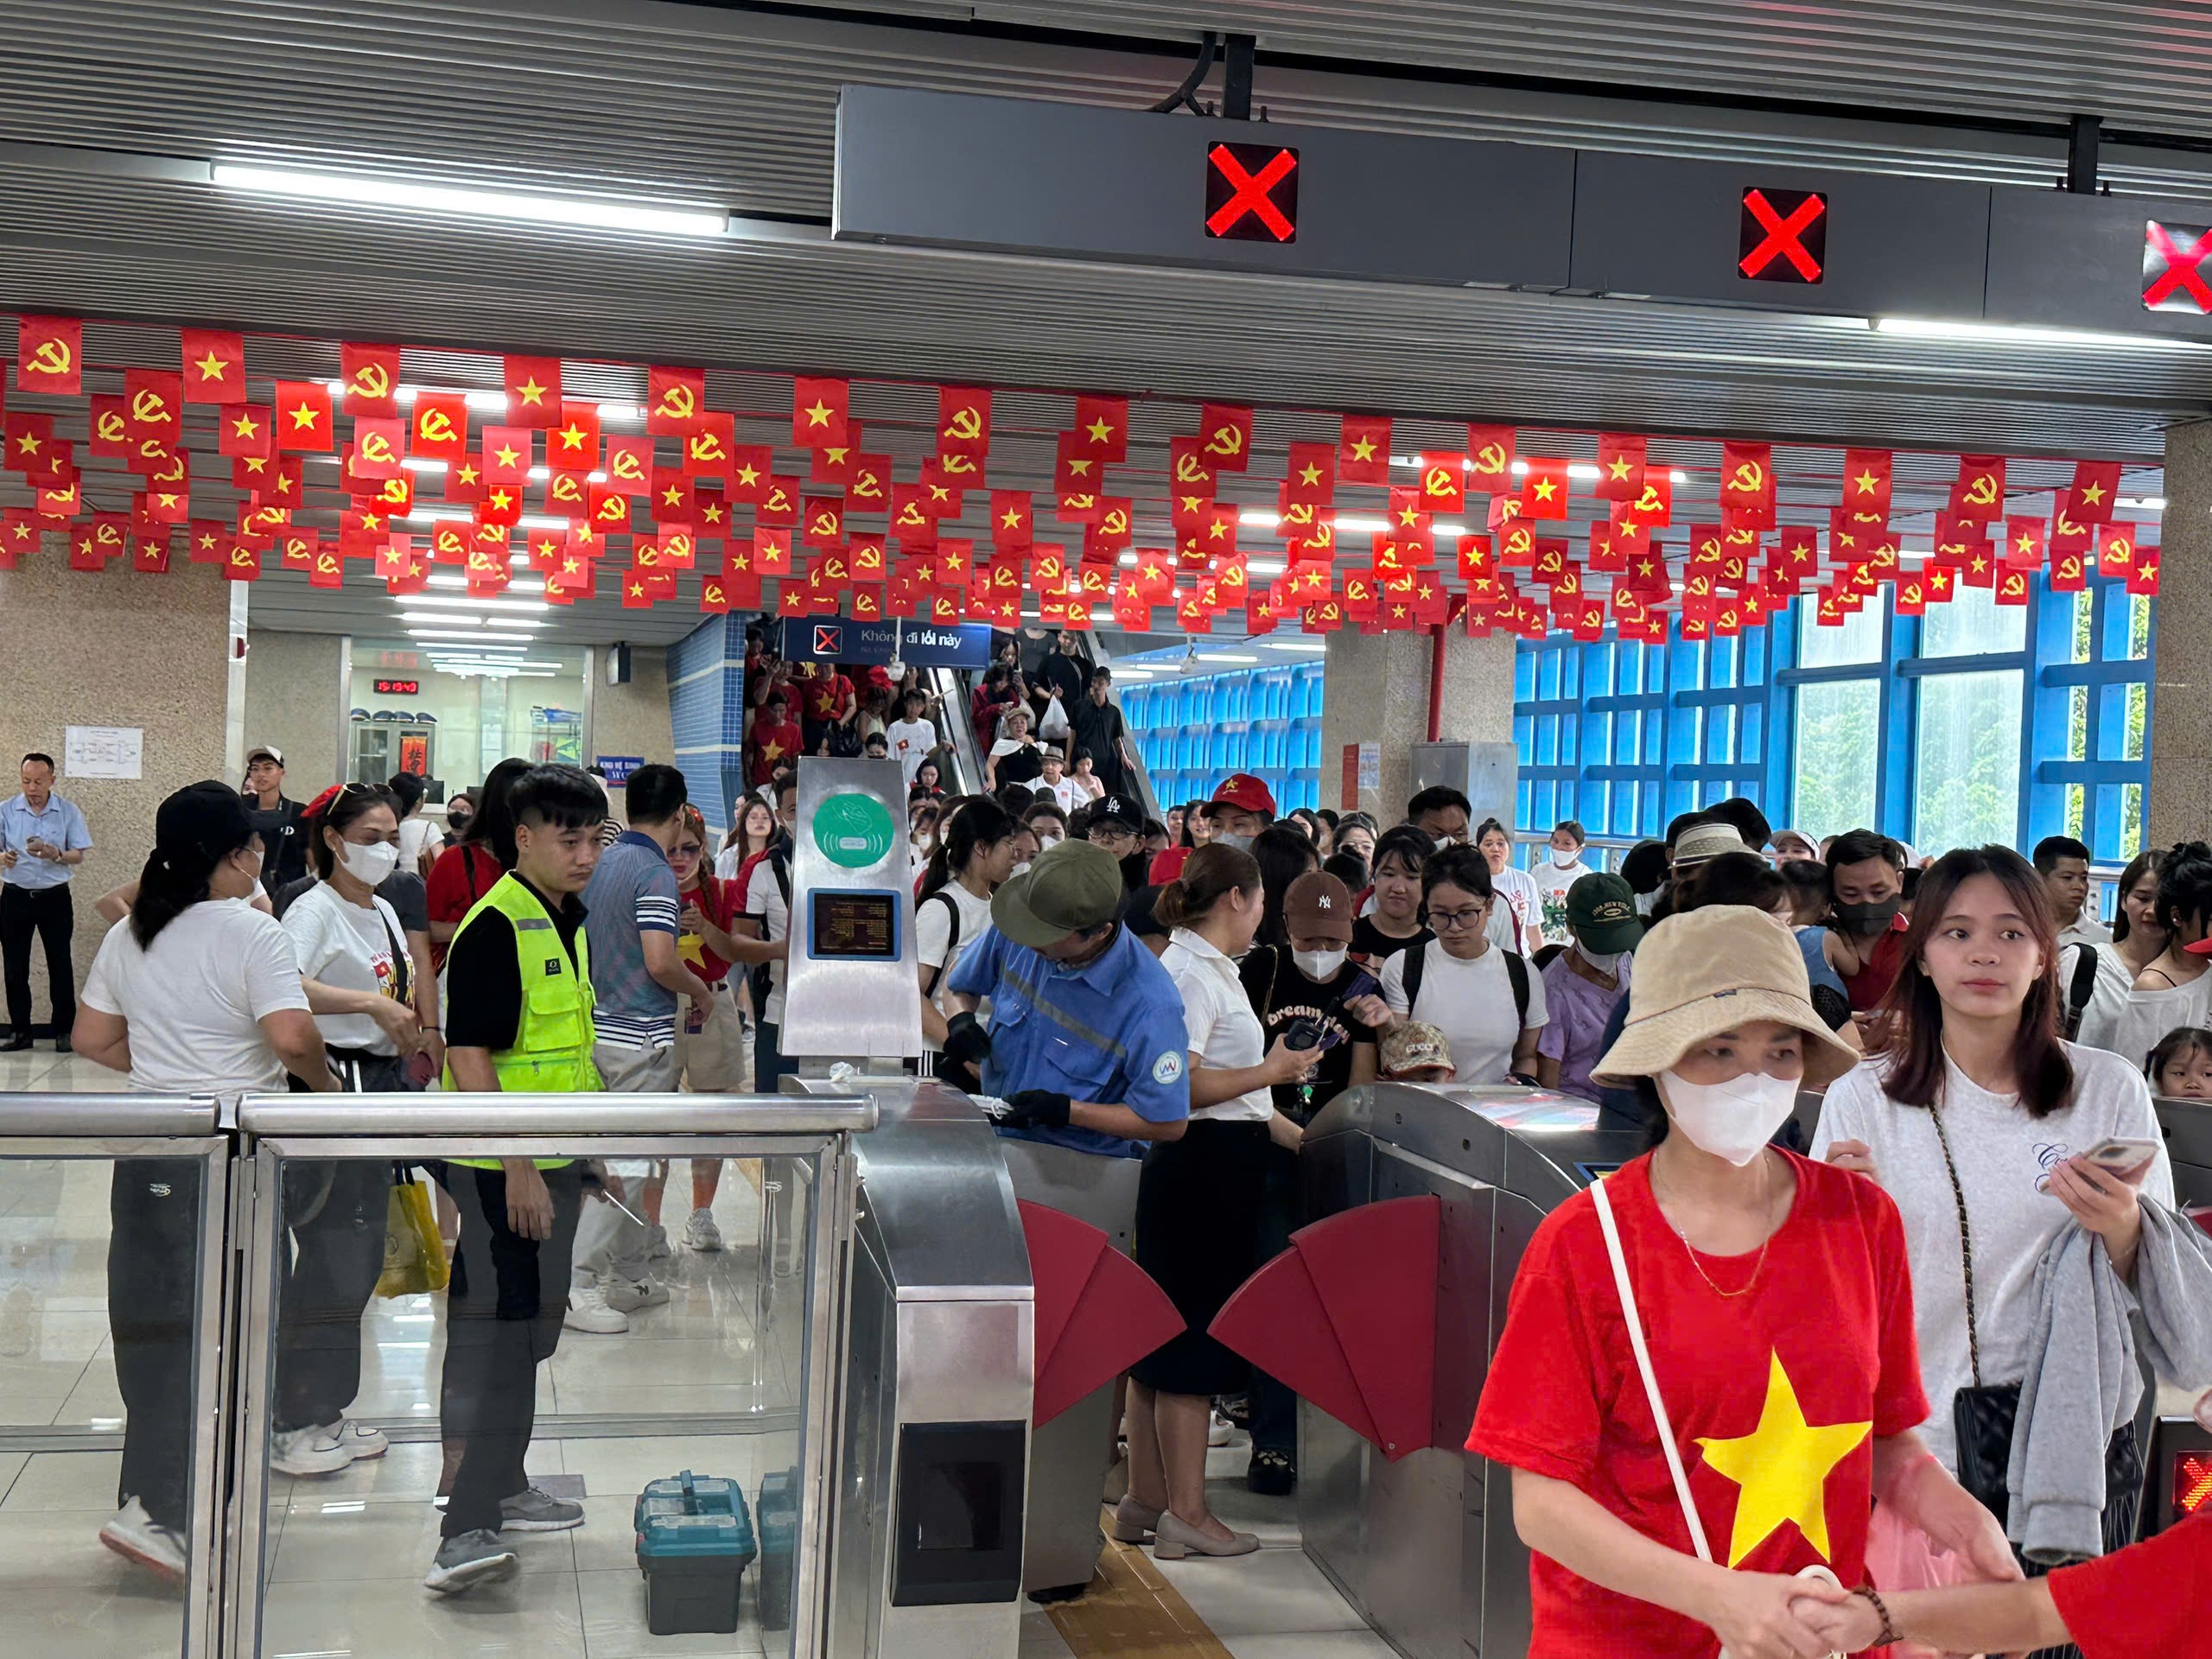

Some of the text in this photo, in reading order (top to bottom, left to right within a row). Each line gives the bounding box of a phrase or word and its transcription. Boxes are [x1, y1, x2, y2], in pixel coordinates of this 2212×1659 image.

[938, 632, 962, 649] này
[1107, 797, 1121, 813] LA
[1319, 895, 1331, 909] NY
[1406, 1042, 1434, 1053] GUCCI
